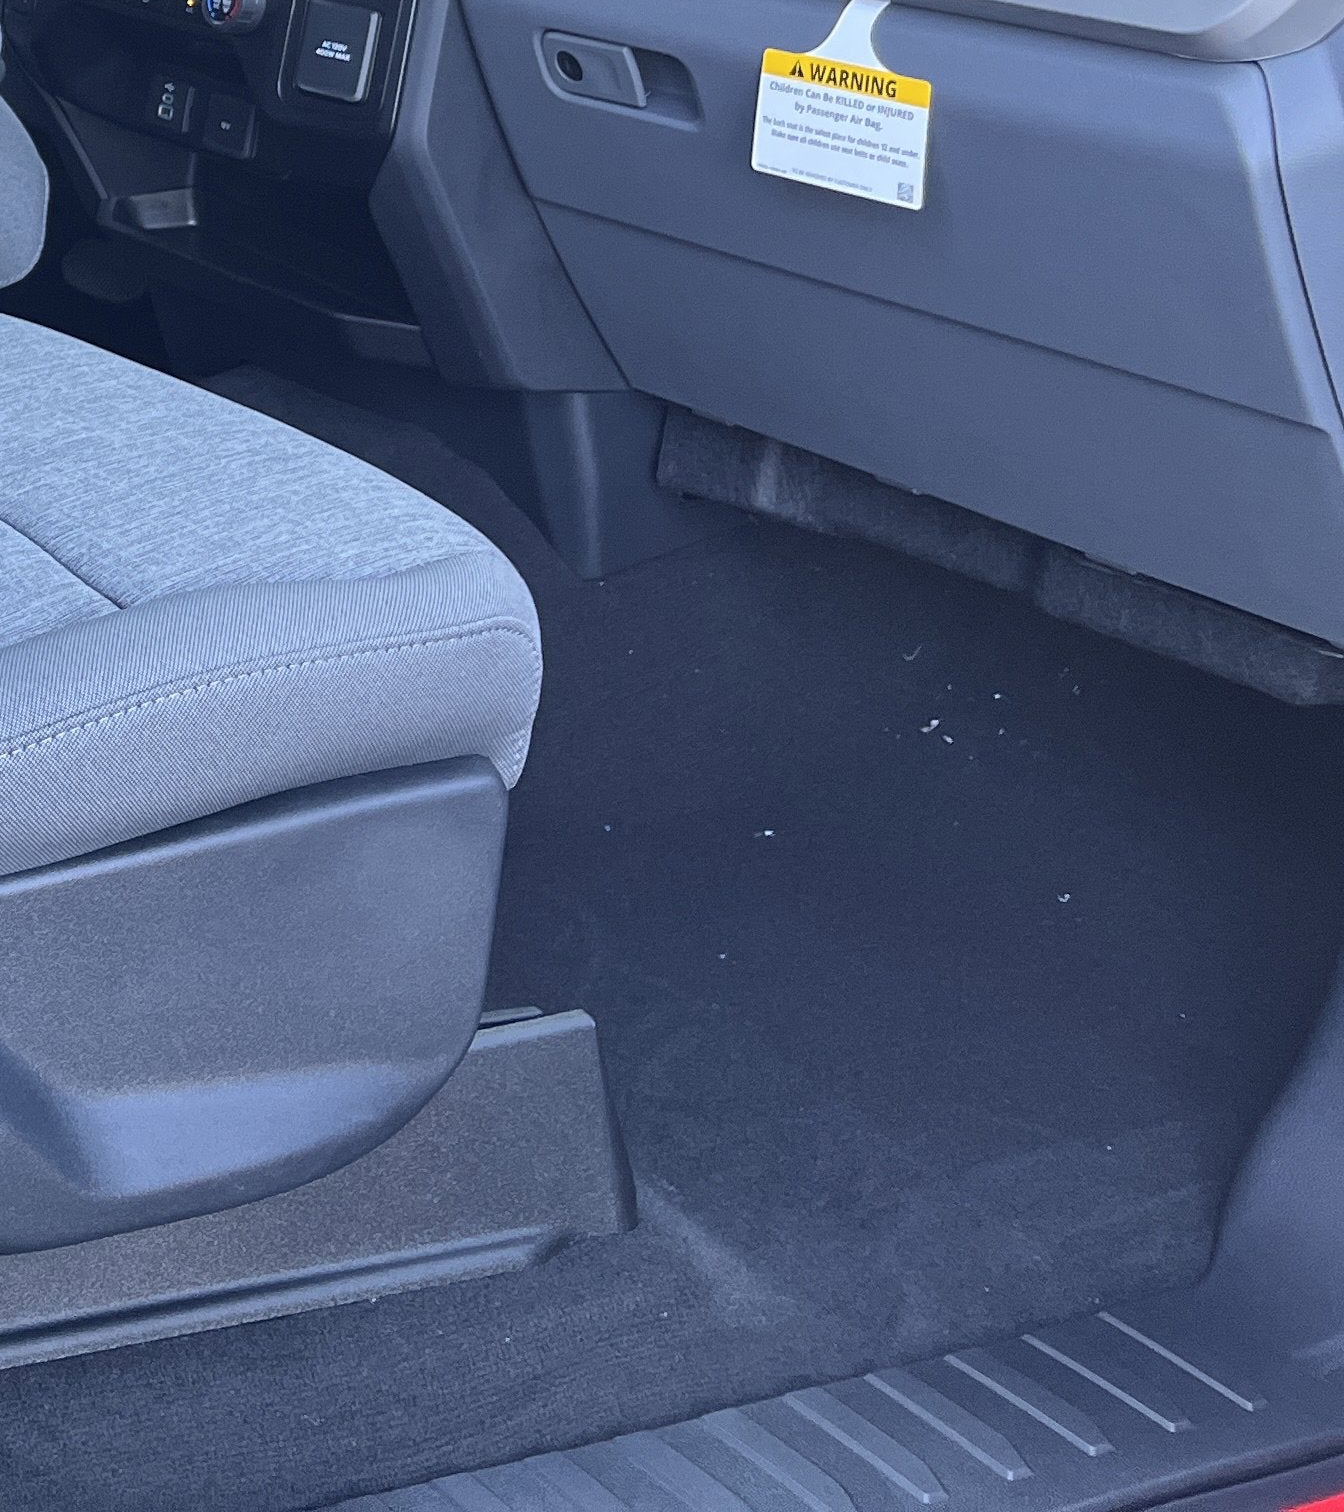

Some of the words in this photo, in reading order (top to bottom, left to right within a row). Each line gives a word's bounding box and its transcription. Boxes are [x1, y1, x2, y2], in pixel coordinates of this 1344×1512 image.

[810, 62, 897, 98] WARNING
[769, 80, 803, 97] Children
[806, 88, 822, 100] Can
[823, 92, 834, 104] Be
[835, 95, 864, 110] KILLED
[866, 102, 876, 112] or
[877, 104, 914, 121] INJURED
[794, 101, 805, 114] by
[807, 103, 848, 123] Passenger
[849, 112, 863, 126] Air
[864, 116, 882, 131] Bag.
